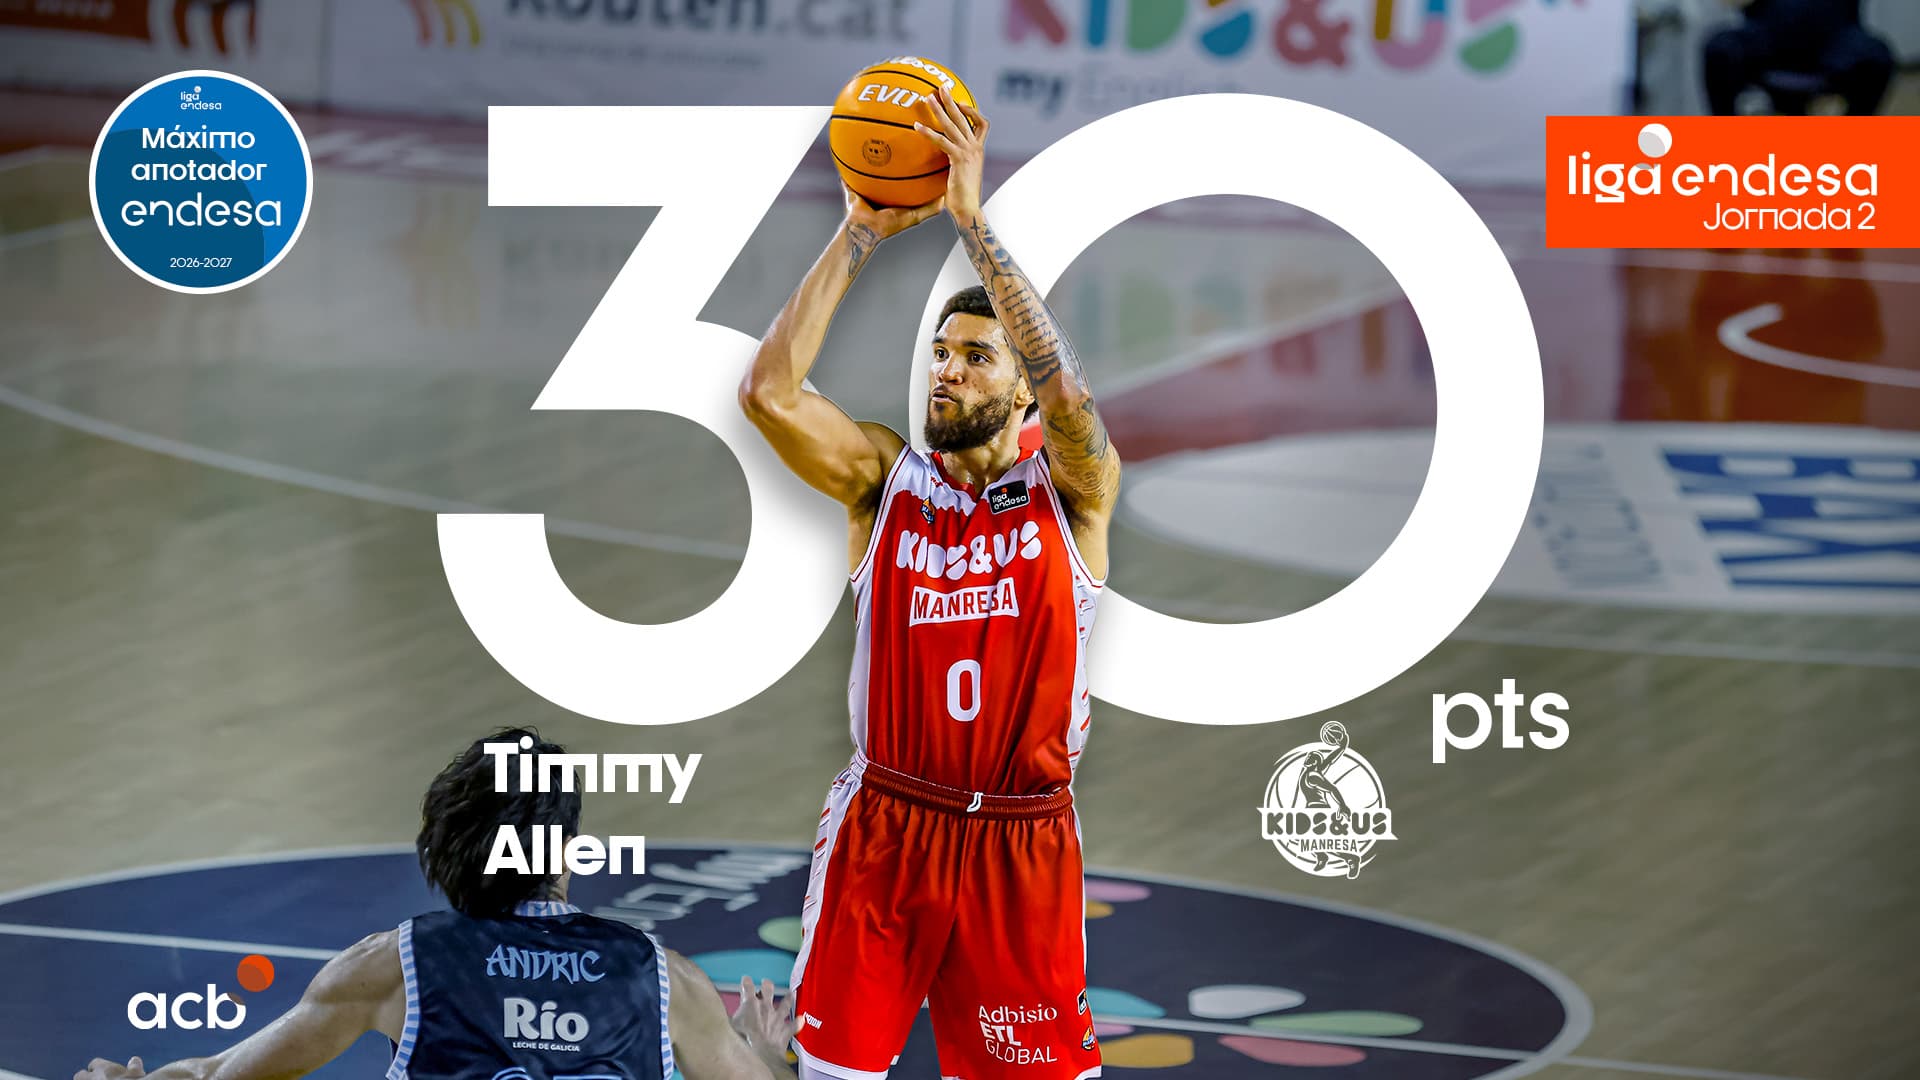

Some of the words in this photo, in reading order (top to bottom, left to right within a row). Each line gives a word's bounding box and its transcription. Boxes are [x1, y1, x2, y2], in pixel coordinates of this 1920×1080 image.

[896, 521, 1042, 580] KIDS&US
[914, 583, 1015, 619] MANRESA
[946, 659, 981, 722] 0
[486, 944, 606, 984] ANDRIC
[979, 1003, 1058, 1024] Adbisio
[512, 1041, 537, 1049] LECHE
[550, 1043, 580, 1052] GALICIA
[980, 1021, 1022, 1046] ETL
[985, 1039, 1058, 1065] GLOBAL
